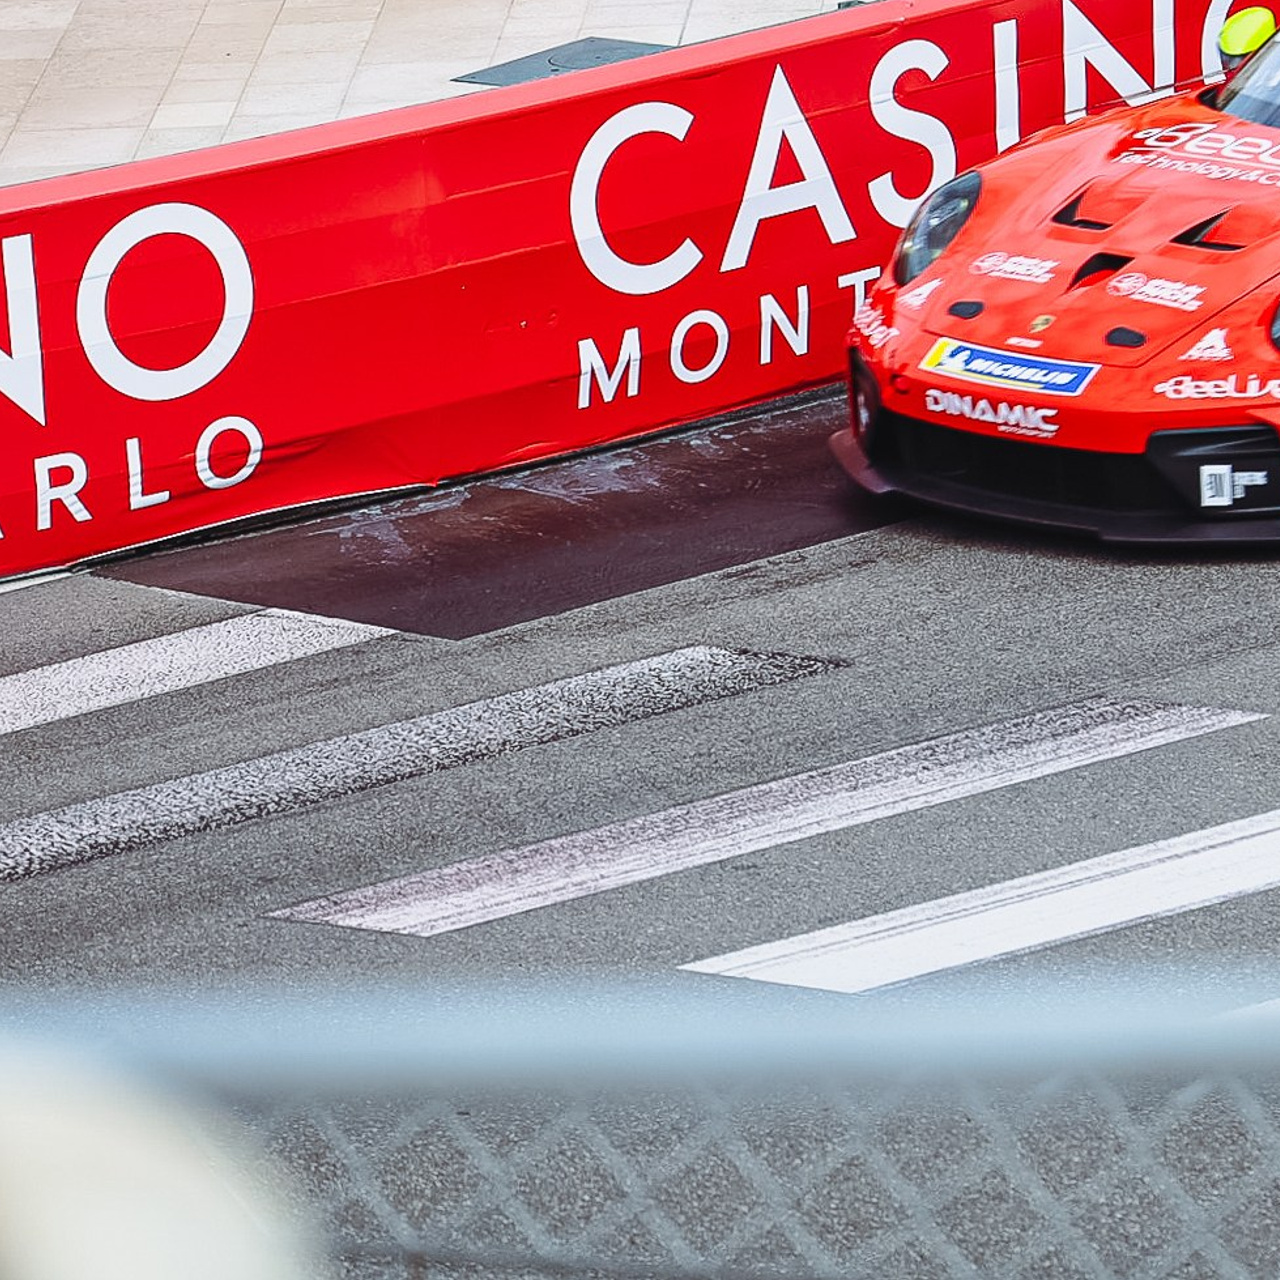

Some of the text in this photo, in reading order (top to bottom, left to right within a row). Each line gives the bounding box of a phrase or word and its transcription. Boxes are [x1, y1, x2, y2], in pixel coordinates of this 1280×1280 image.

[967, 357, 1078, 385] MICHELIN
[925, 388, 1060, 432] DINAMIC
[0, 415, 264, 539] RLO
